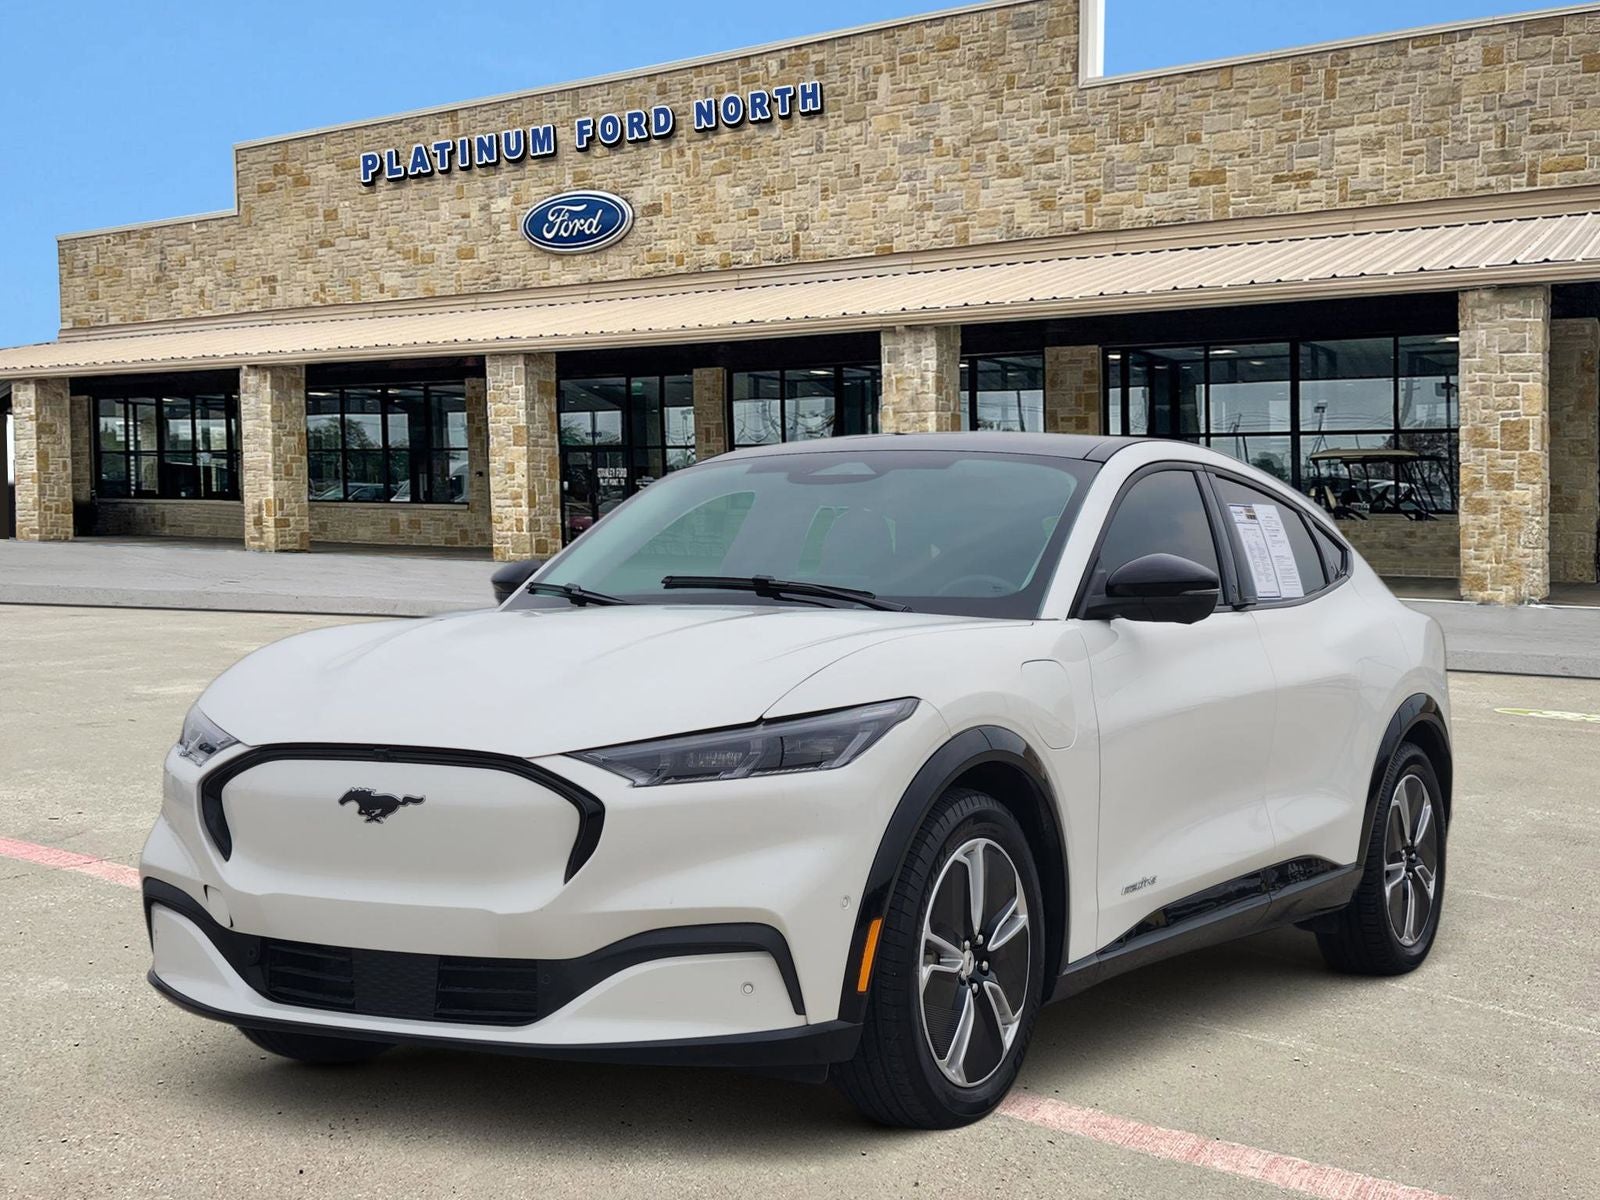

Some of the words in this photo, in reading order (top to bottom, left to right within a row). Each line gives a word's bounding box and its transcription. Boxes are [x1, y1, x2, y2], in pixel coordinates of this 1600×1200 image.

[360, 124, 555, 183] PLATINUM
[575, 105, 674, 149] FORD
[694, 80, 822, 130] NORTH
[542, 203, 603, 239] Ford
